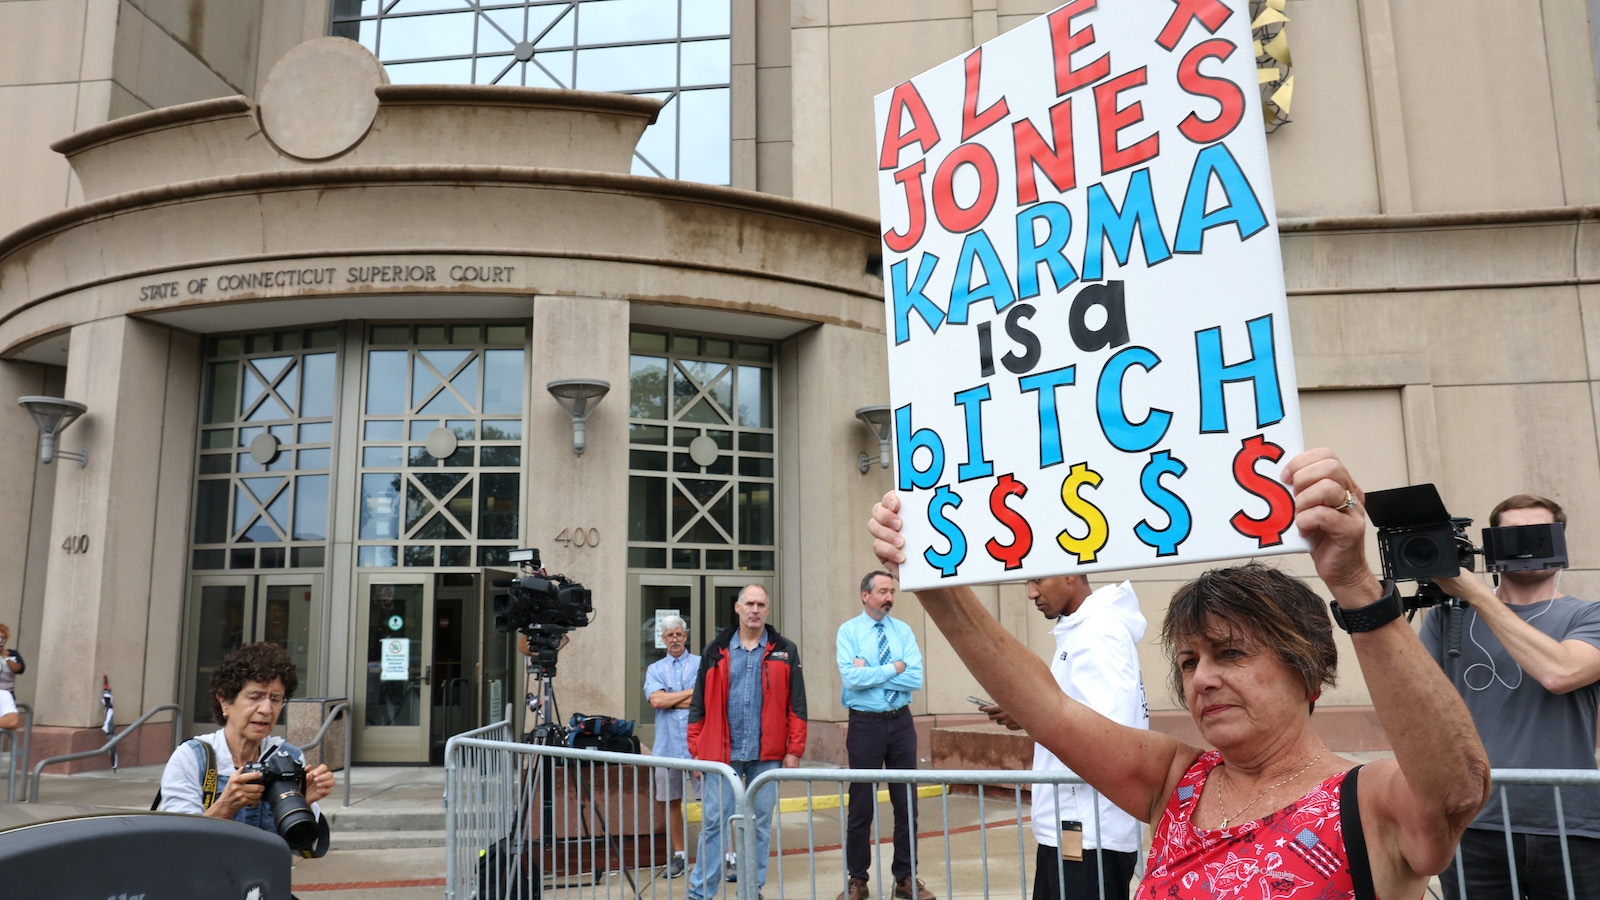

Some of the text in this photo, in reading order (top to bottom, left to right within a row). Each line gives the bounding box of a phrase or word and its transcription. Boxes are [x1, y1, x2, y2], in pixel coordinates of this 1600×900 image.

[879, 0, 1234, 170] ALEX
[883, 38, 1246, 252] JONES
[890, 142, 1269, 346] KARMA
[139, 265, 515, 301] STATE OF CONNECTICUT SUPERIOR COURT
[1069, 280, 1130, 352] a
[61, 534, 90, 555] 400
[553, 526, 600, 548] 400
[1260, 867, 1294, 879] Columbia
